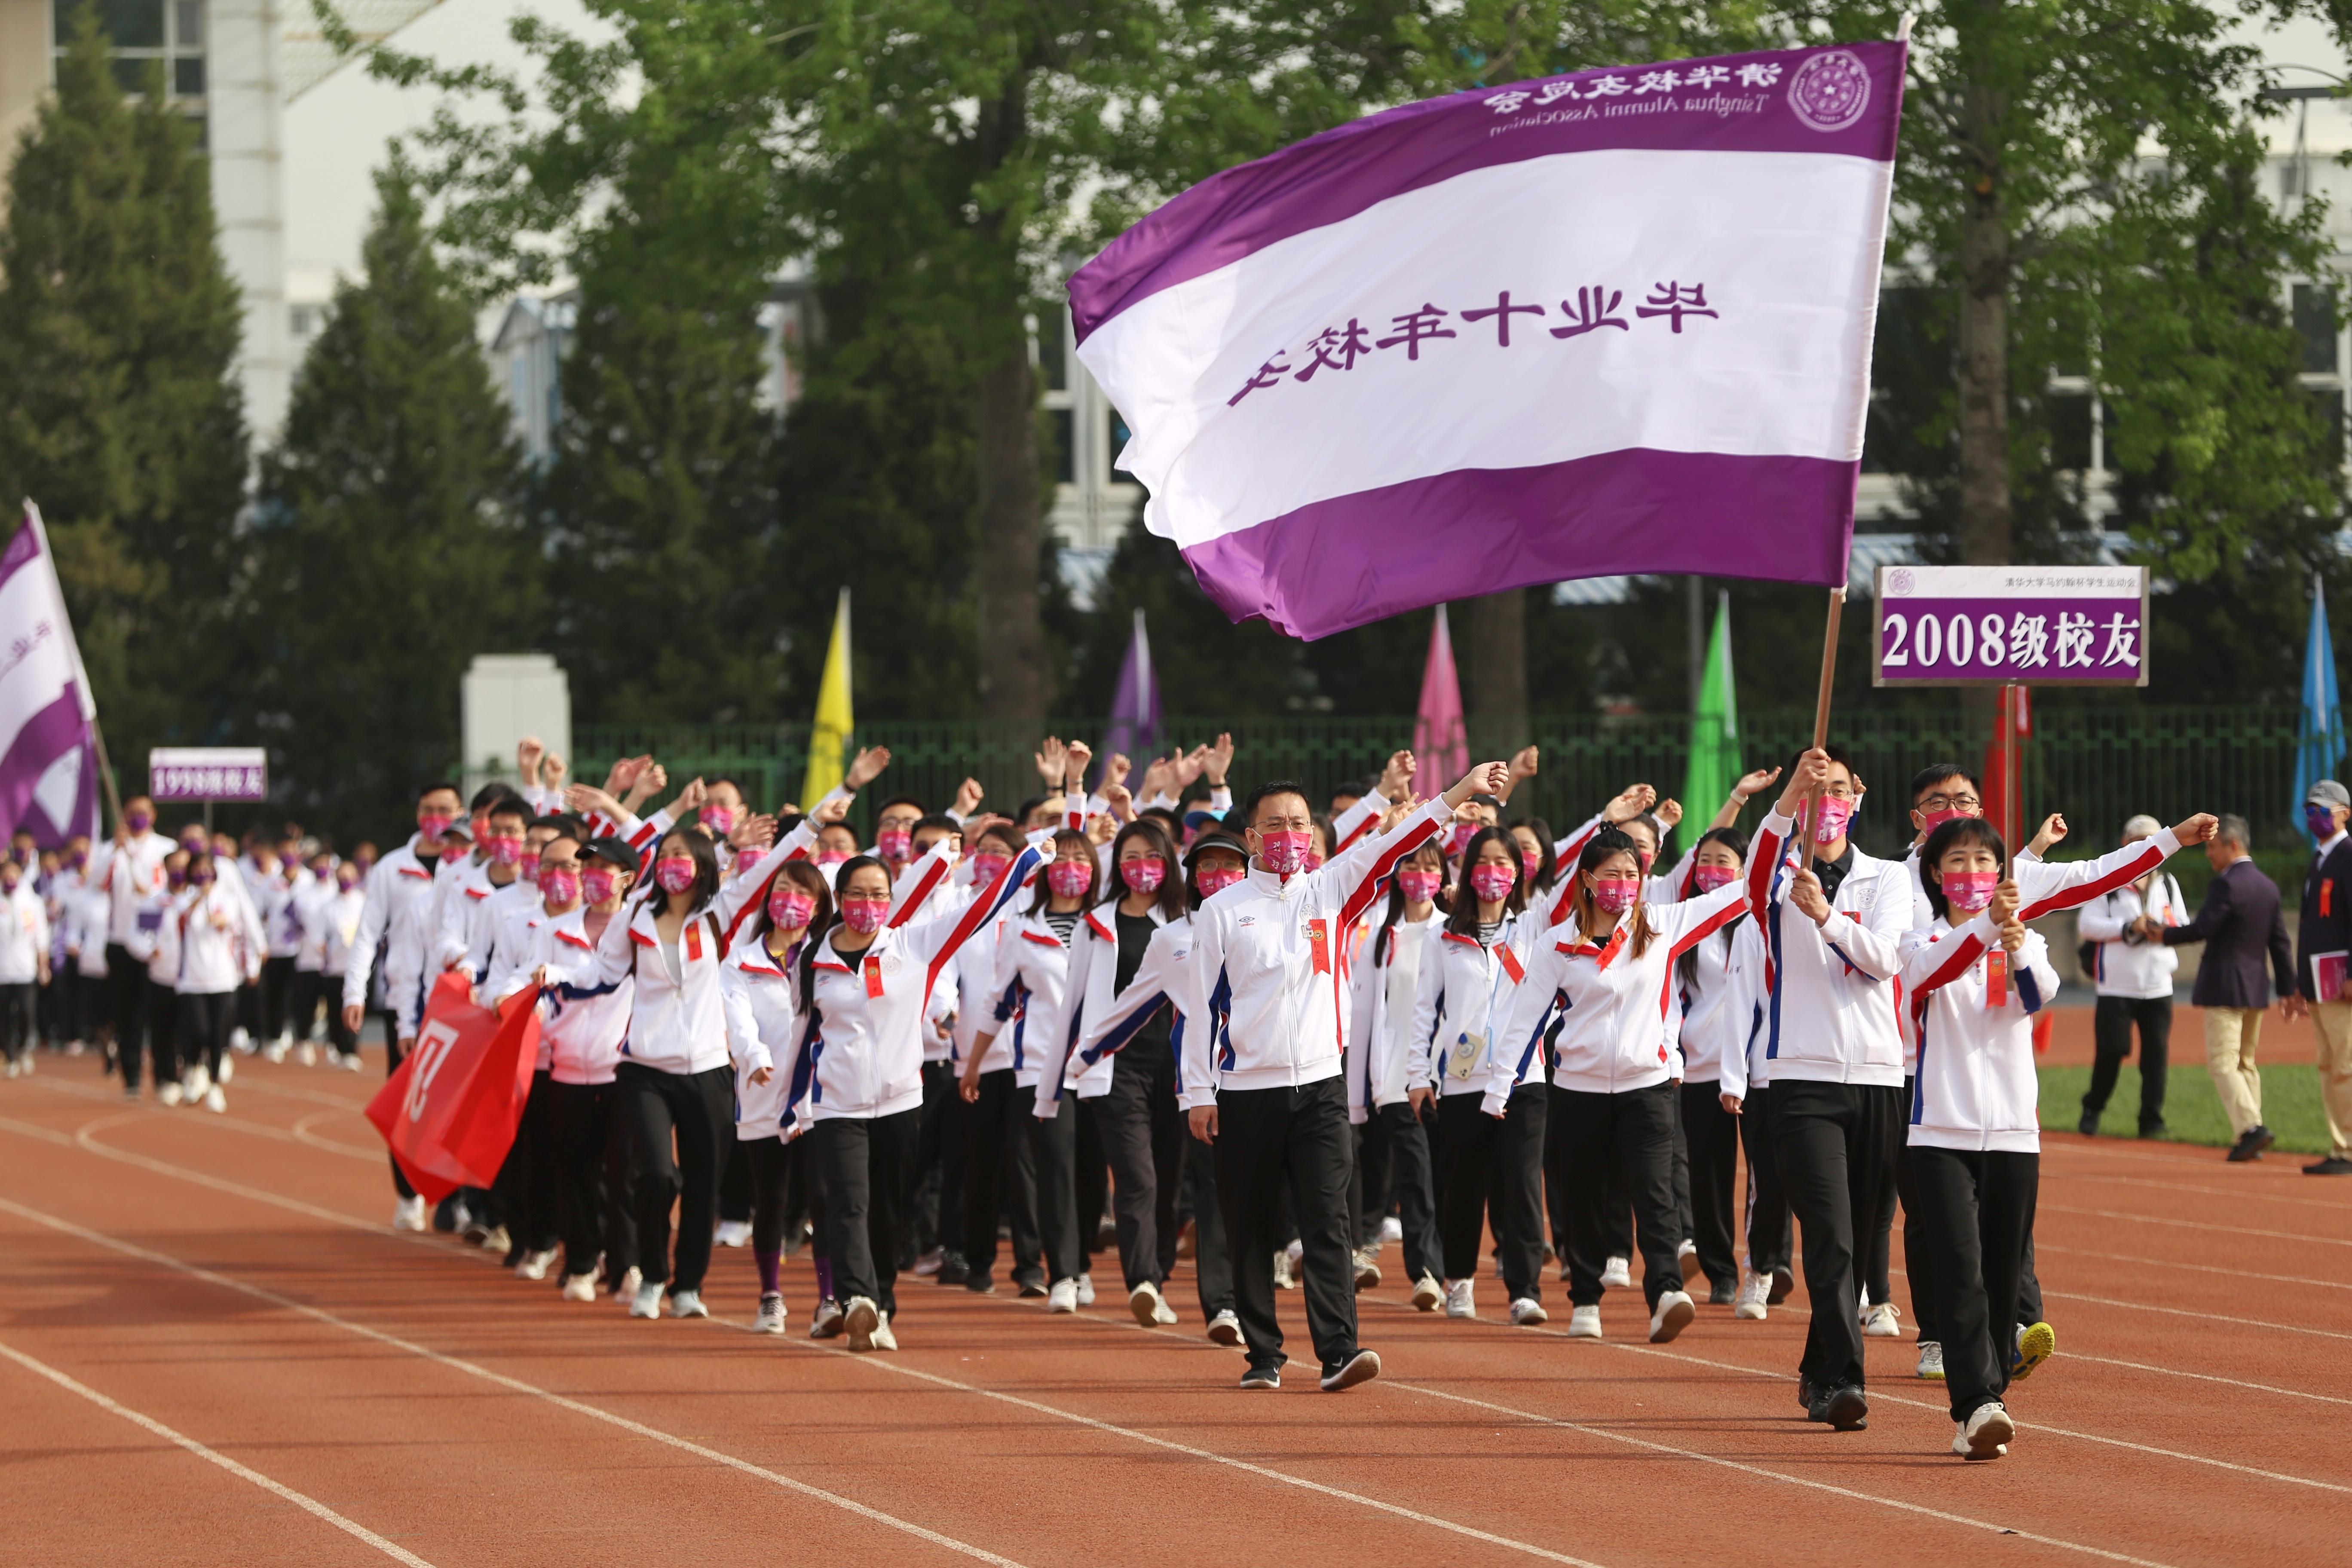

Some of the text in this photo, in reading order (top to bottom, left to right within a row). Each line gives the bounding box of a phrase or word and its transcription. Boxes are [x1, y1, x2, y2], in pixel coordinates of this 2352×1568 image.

[2005, 577, 2137, 588] 清华大学马约翰杯学生运动会
[1882, 612, 2141, 669] 2008级校友
